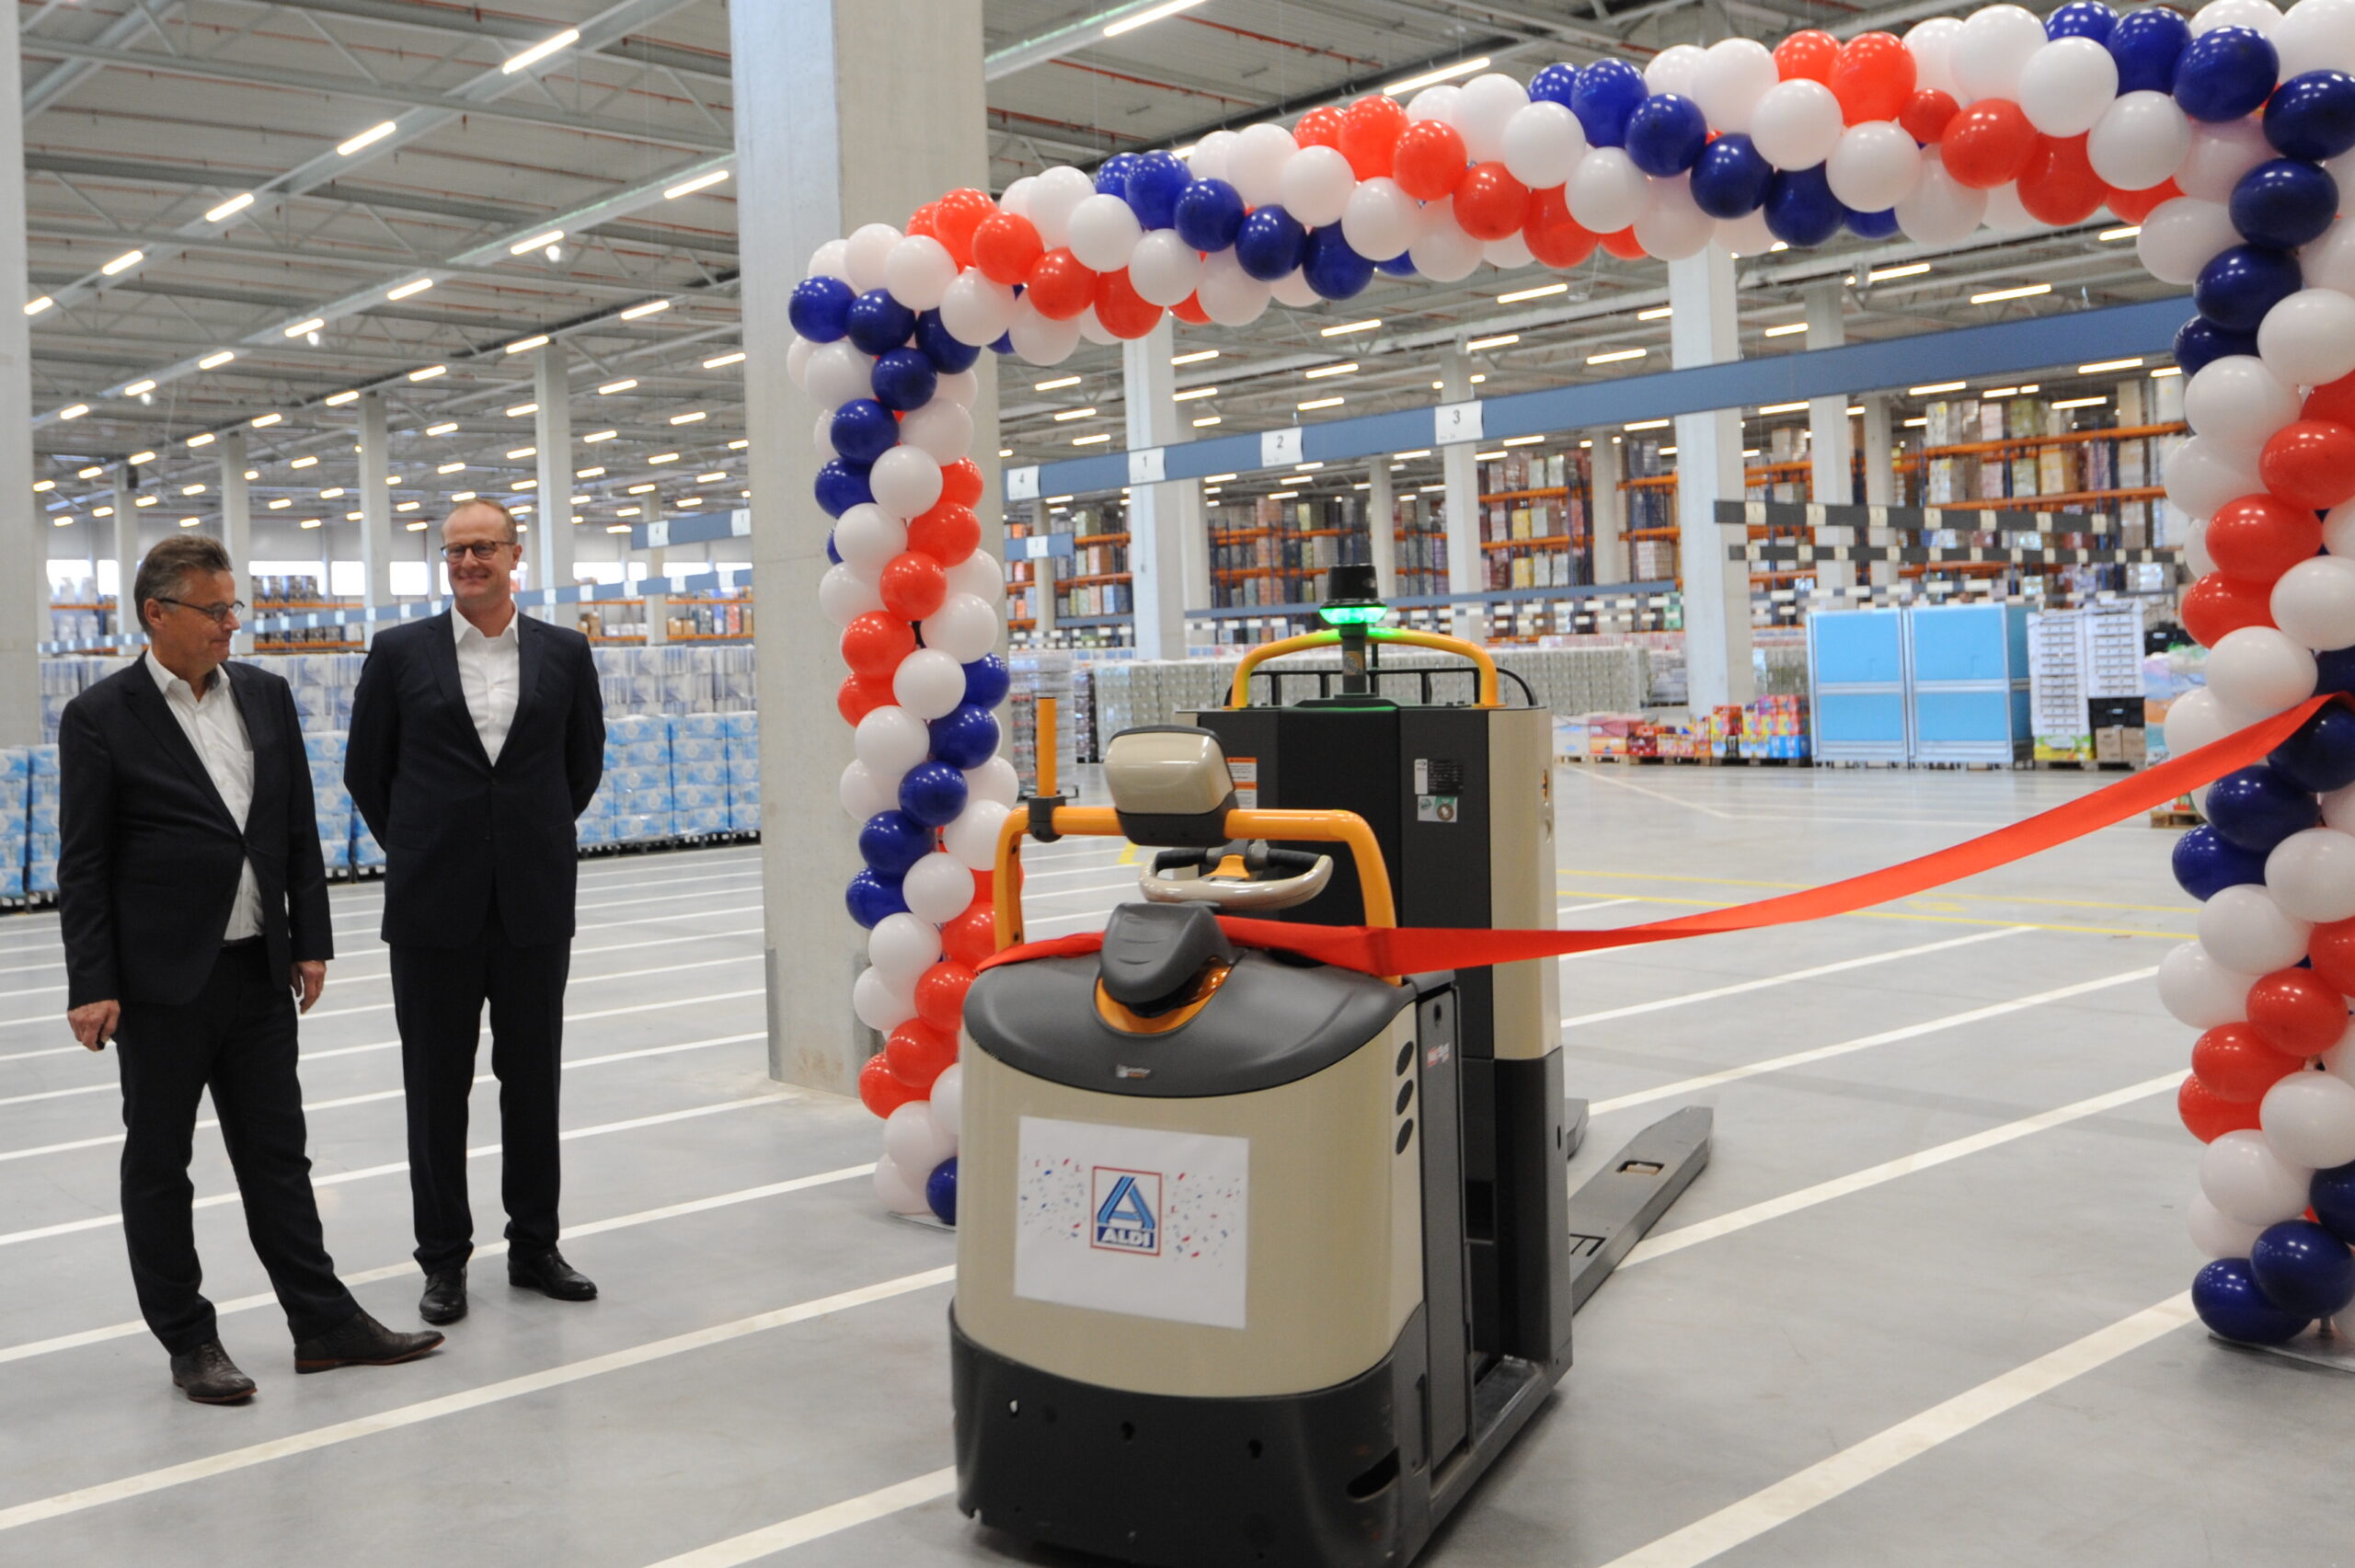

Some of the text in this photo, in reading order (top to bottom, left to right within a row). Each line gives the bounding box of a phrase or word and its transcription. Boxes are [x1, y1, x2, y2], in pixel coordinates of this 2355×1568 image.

[1453, 408, 1462, 425] 3
[1276, 434, 1284, 449] 2
[1101, 1228, 1151, 1247] ALDI
